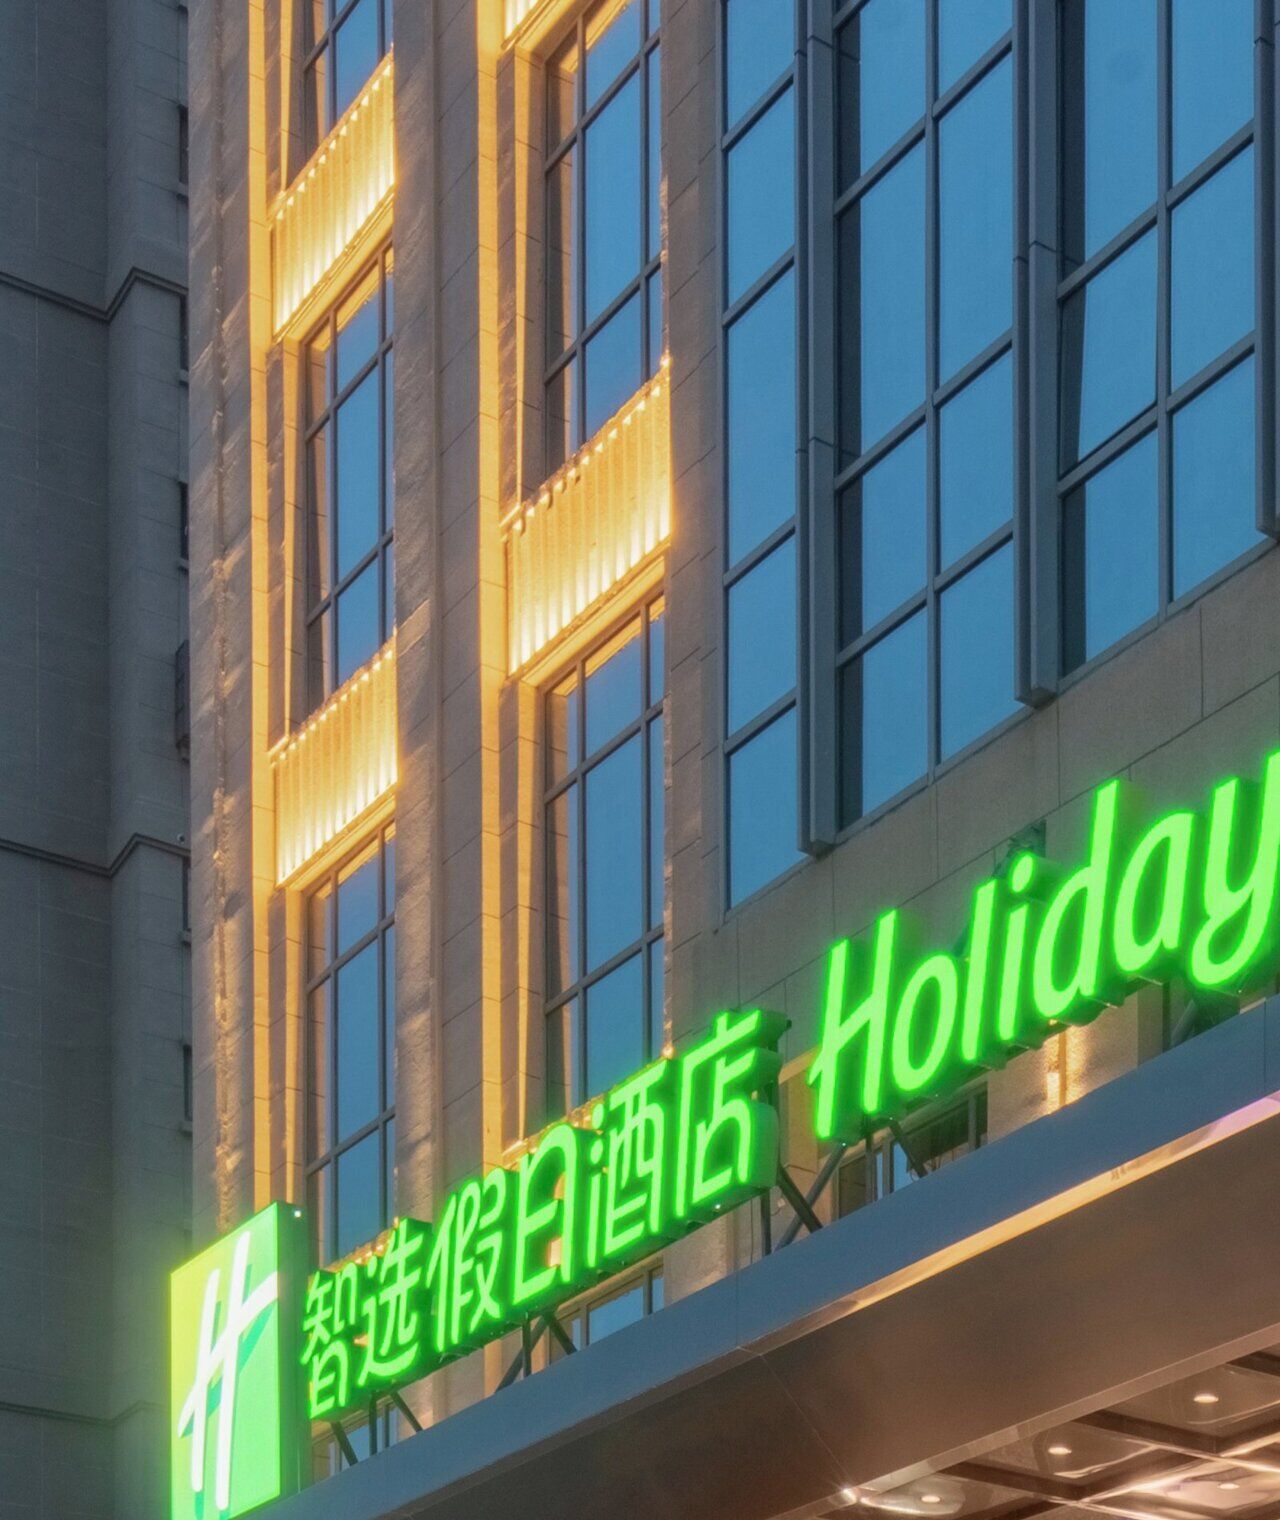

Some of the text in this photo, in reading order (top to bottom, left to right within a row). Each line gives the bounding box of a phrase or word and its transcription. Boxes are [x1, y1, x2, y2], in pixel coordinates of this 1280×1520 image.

[301, 1010, 762, 1421] 智选假日酒店
